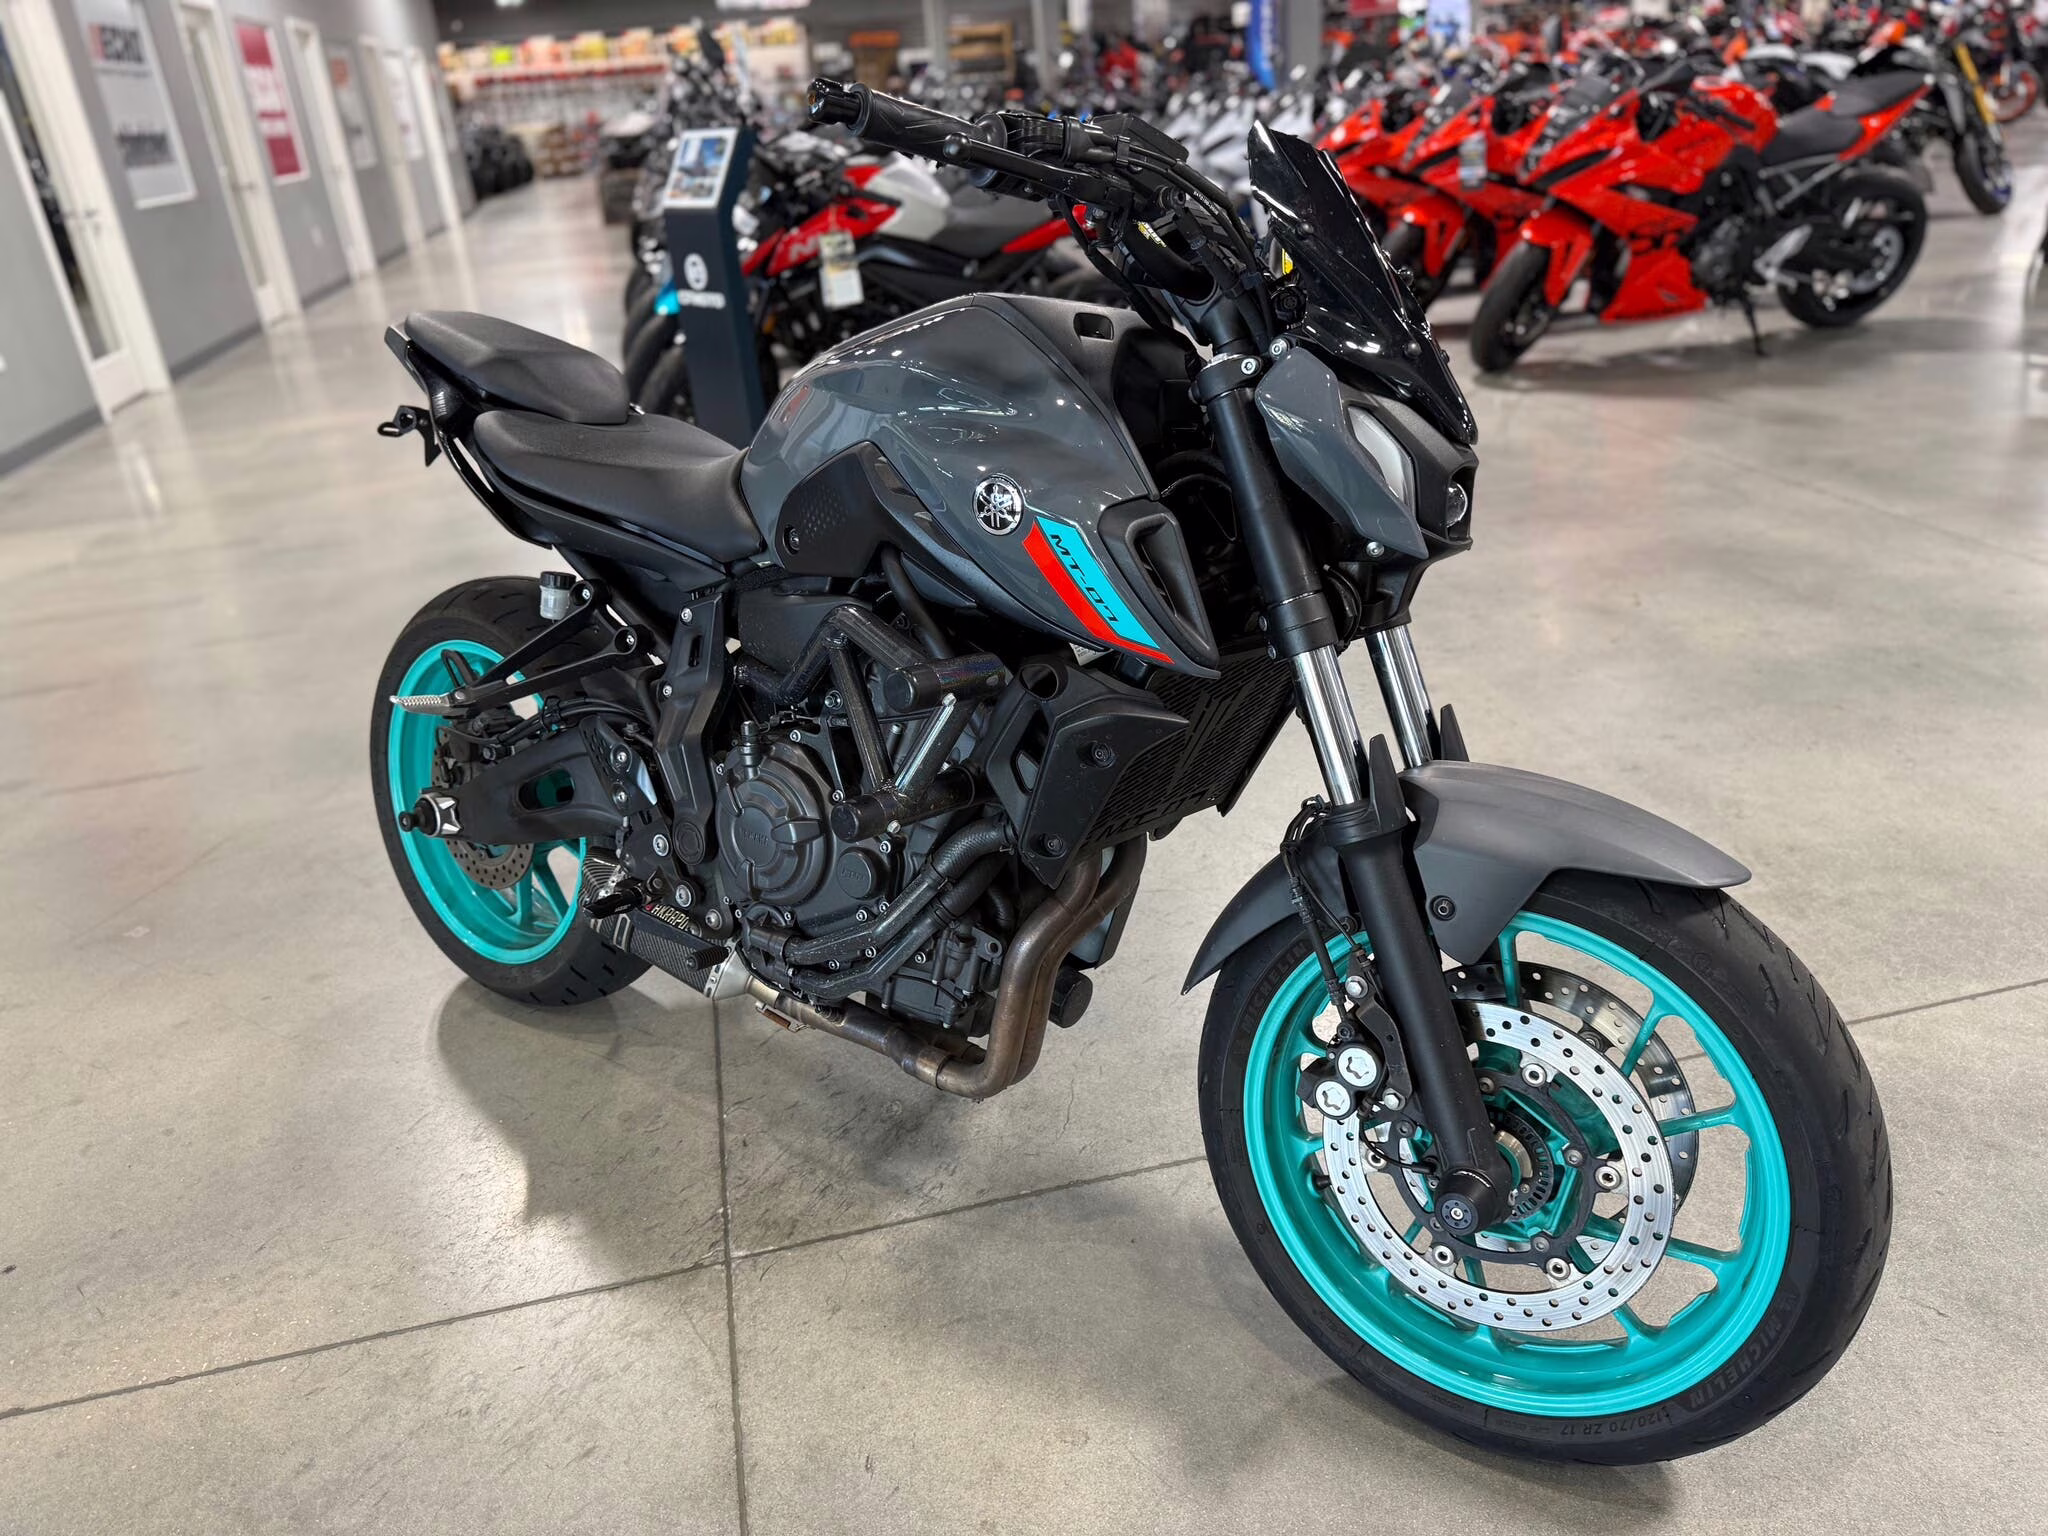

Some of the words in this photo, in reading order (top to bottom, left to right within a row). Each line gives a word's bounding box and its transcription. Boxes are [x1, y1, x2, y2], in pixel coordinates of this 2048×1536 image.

[1050, 534, 1119, 622] MT-07
[651, 903, 690, 932] AKRAPO
[1241, 941, 1309, 1034] MICHELIN
[1689, 1315, 1782, 1409] MICHELIN
[1560, 1423, 1576, 1436] 17
[1583, 1423, 1602, 1436] ZR
[1609, 1414, 1663, 1433] 120/70
